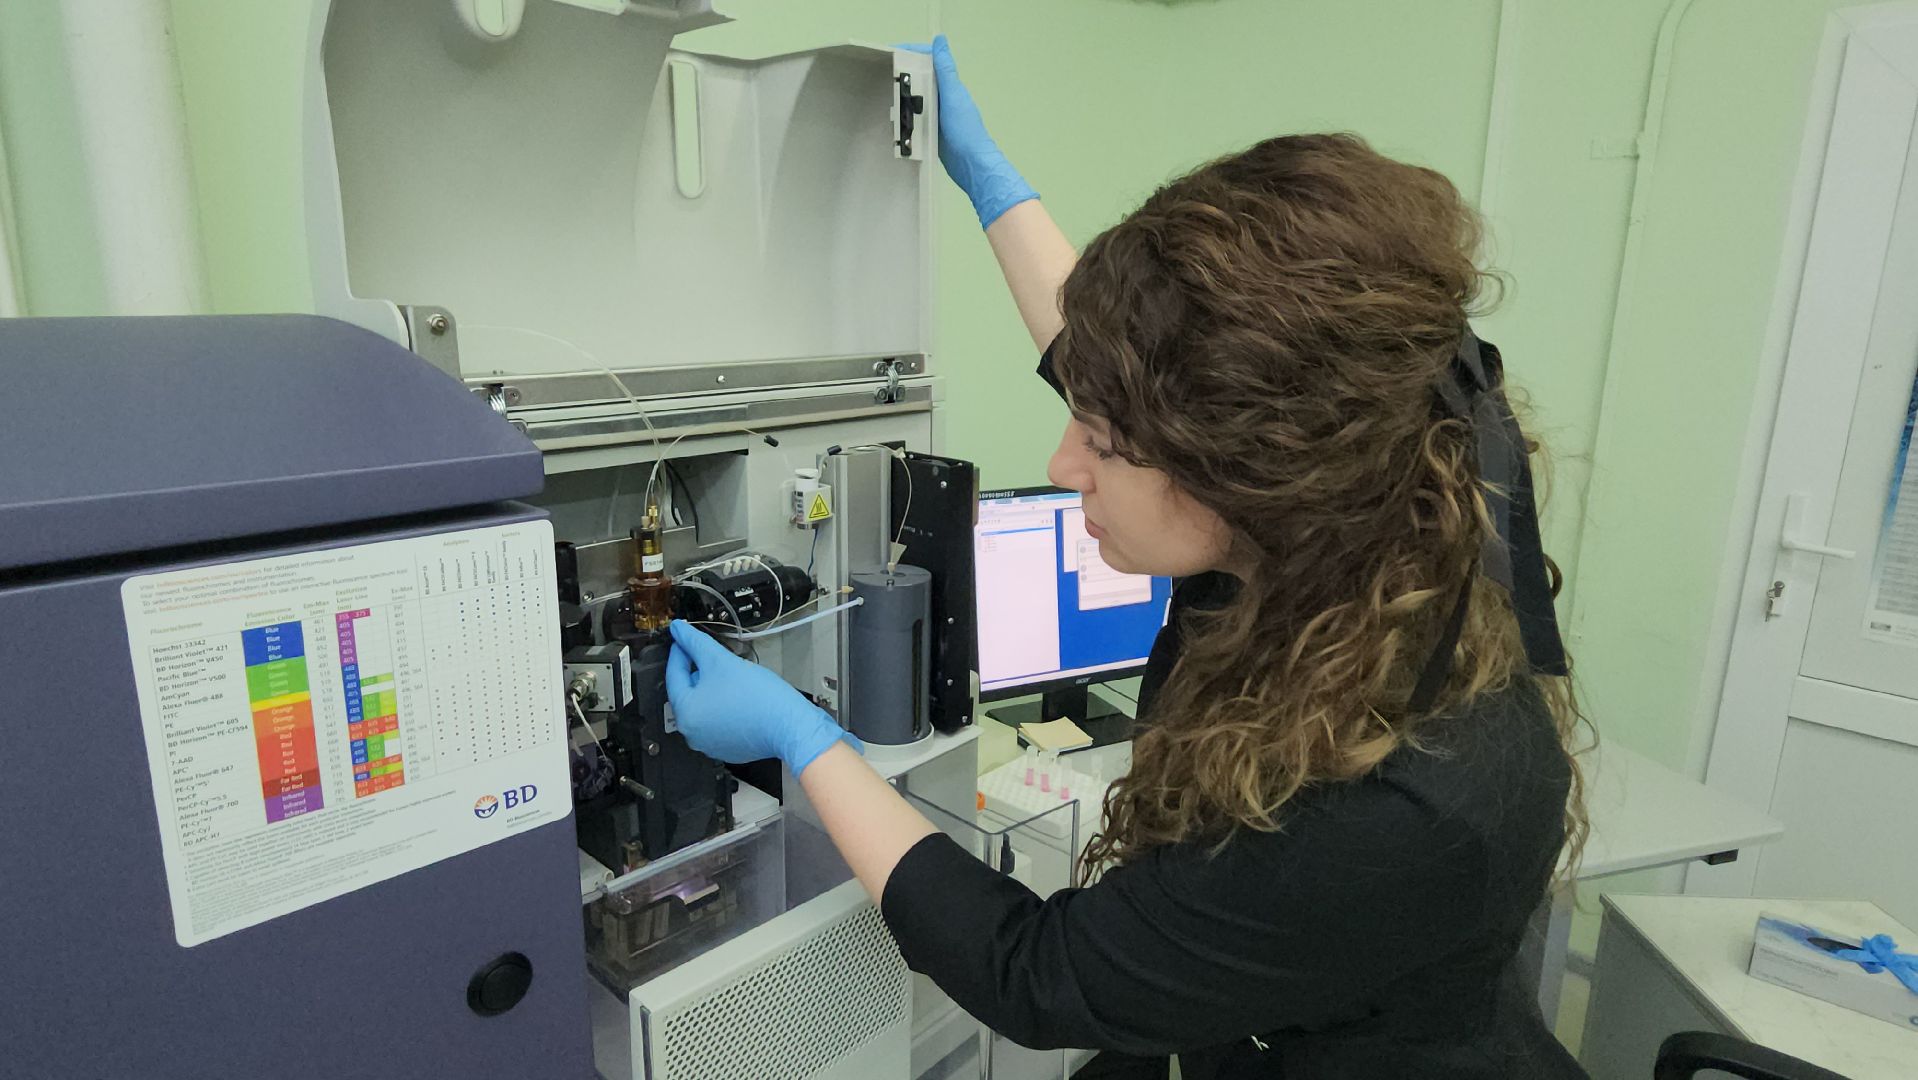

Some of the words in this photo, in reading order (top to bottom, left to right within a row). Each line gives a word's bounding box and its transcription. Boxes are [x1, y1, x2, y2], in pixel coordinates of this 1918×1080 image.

[266, 635, 280, 643] Blue
[152, 644, 182, 654] Hoechst
[155, 653, 183, 663] Brilliant
[206, 655, 224, 664] V450
[158, 674, 180, 682] Pacific
[161, 692, 190, 702] AmCyan
[163, 702, 182, 710] Alexa
[272, 705, 293, 715] Orange
[163, 711, 179, 720] FITC
[272, 715, 294, 724] Orange
[274, 724, 295, 733] Orange
[166, 729, 195, 739] Brilliant
[171, 757, 194, 766] 7-AAD
[174, 776, 194, 785] Alexa
[176, 793, 197, 803] PerCP
[282, 791, 305, 801] Infrared
[503, 784, 537, 809] BD
[284, 799, 306, 810] Infrared
[179, 812, 199, 821] Alexa
[284, 808, 307, 818] Infrared
